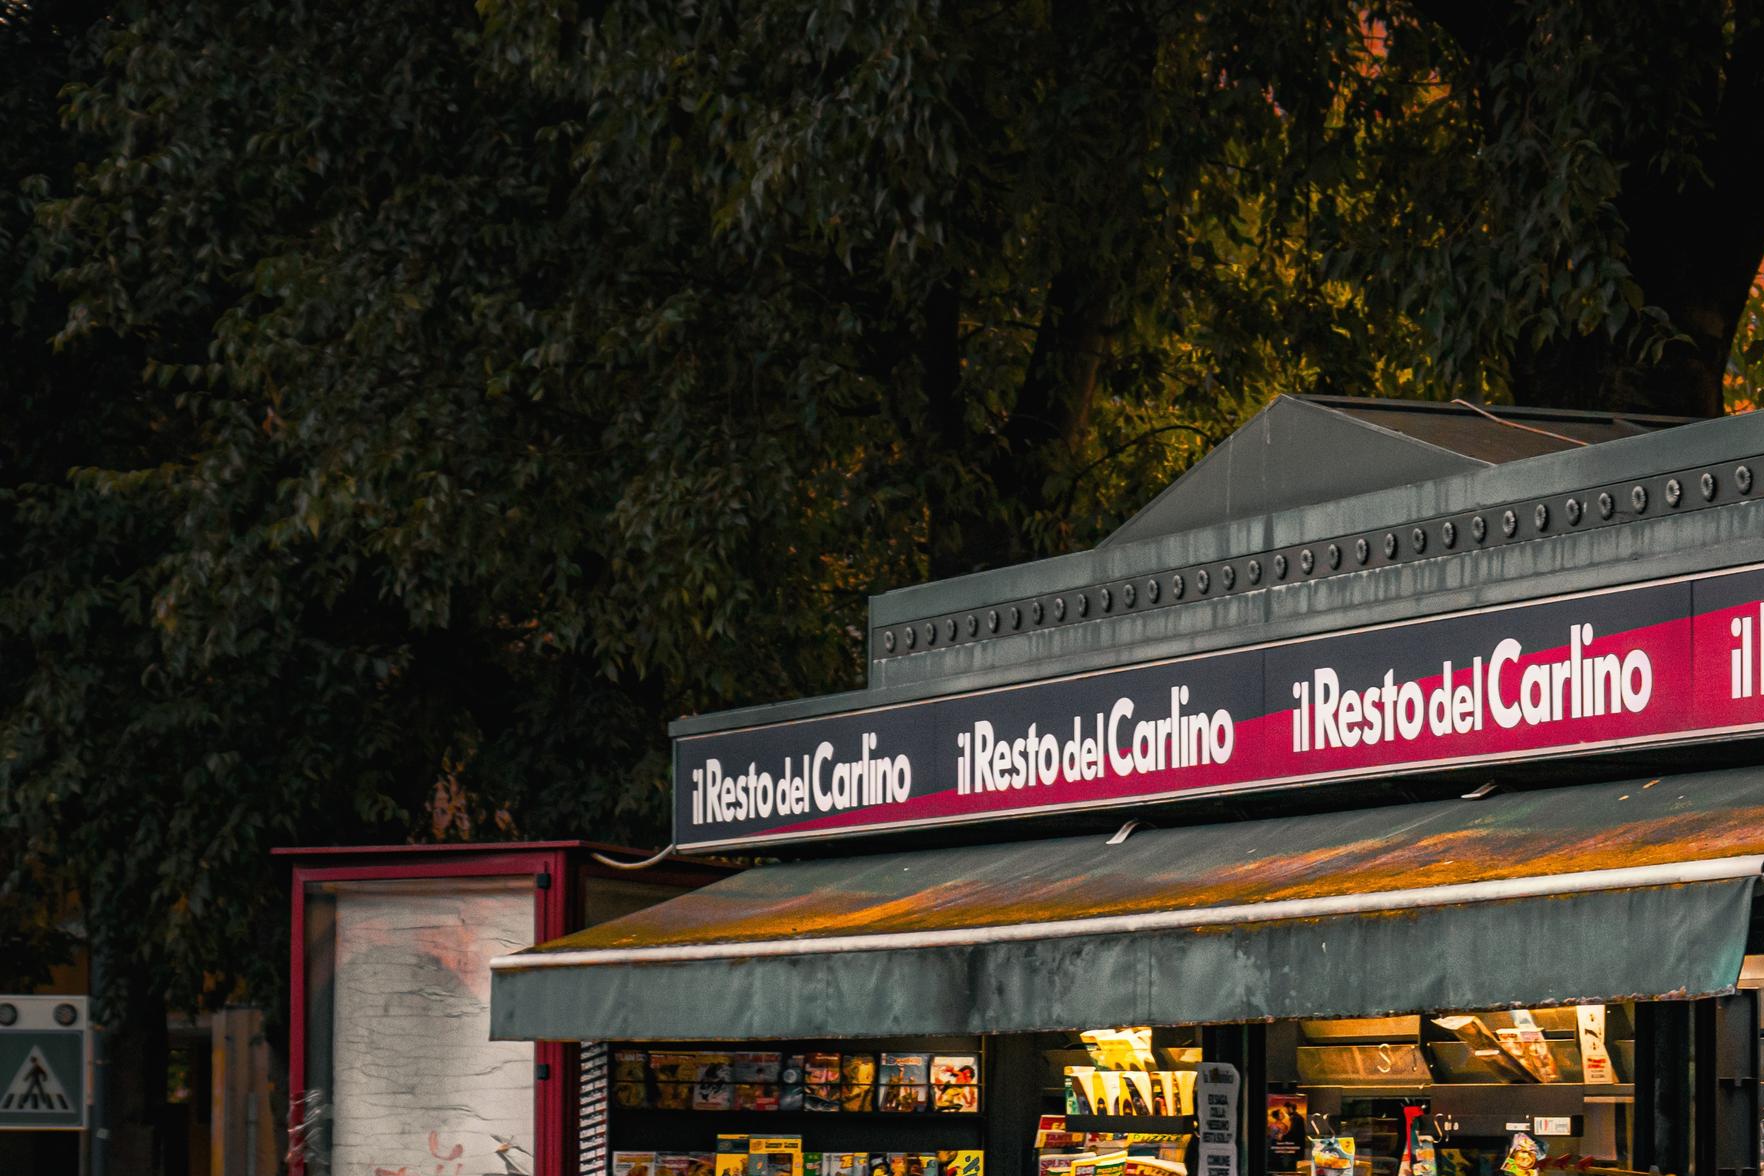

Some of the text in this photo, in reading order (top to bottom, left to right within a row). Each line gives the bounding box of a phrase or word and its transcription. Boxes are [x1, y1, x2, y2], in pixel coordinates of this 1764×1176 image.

[1292, 622, 1653, 753] il Resto del Carlino
[1730, 616, 1753, 698] il
[692, 731, 912, 825] il Resto del Carlino
[957, 684, 1235, 796] il Resto del Carlino
